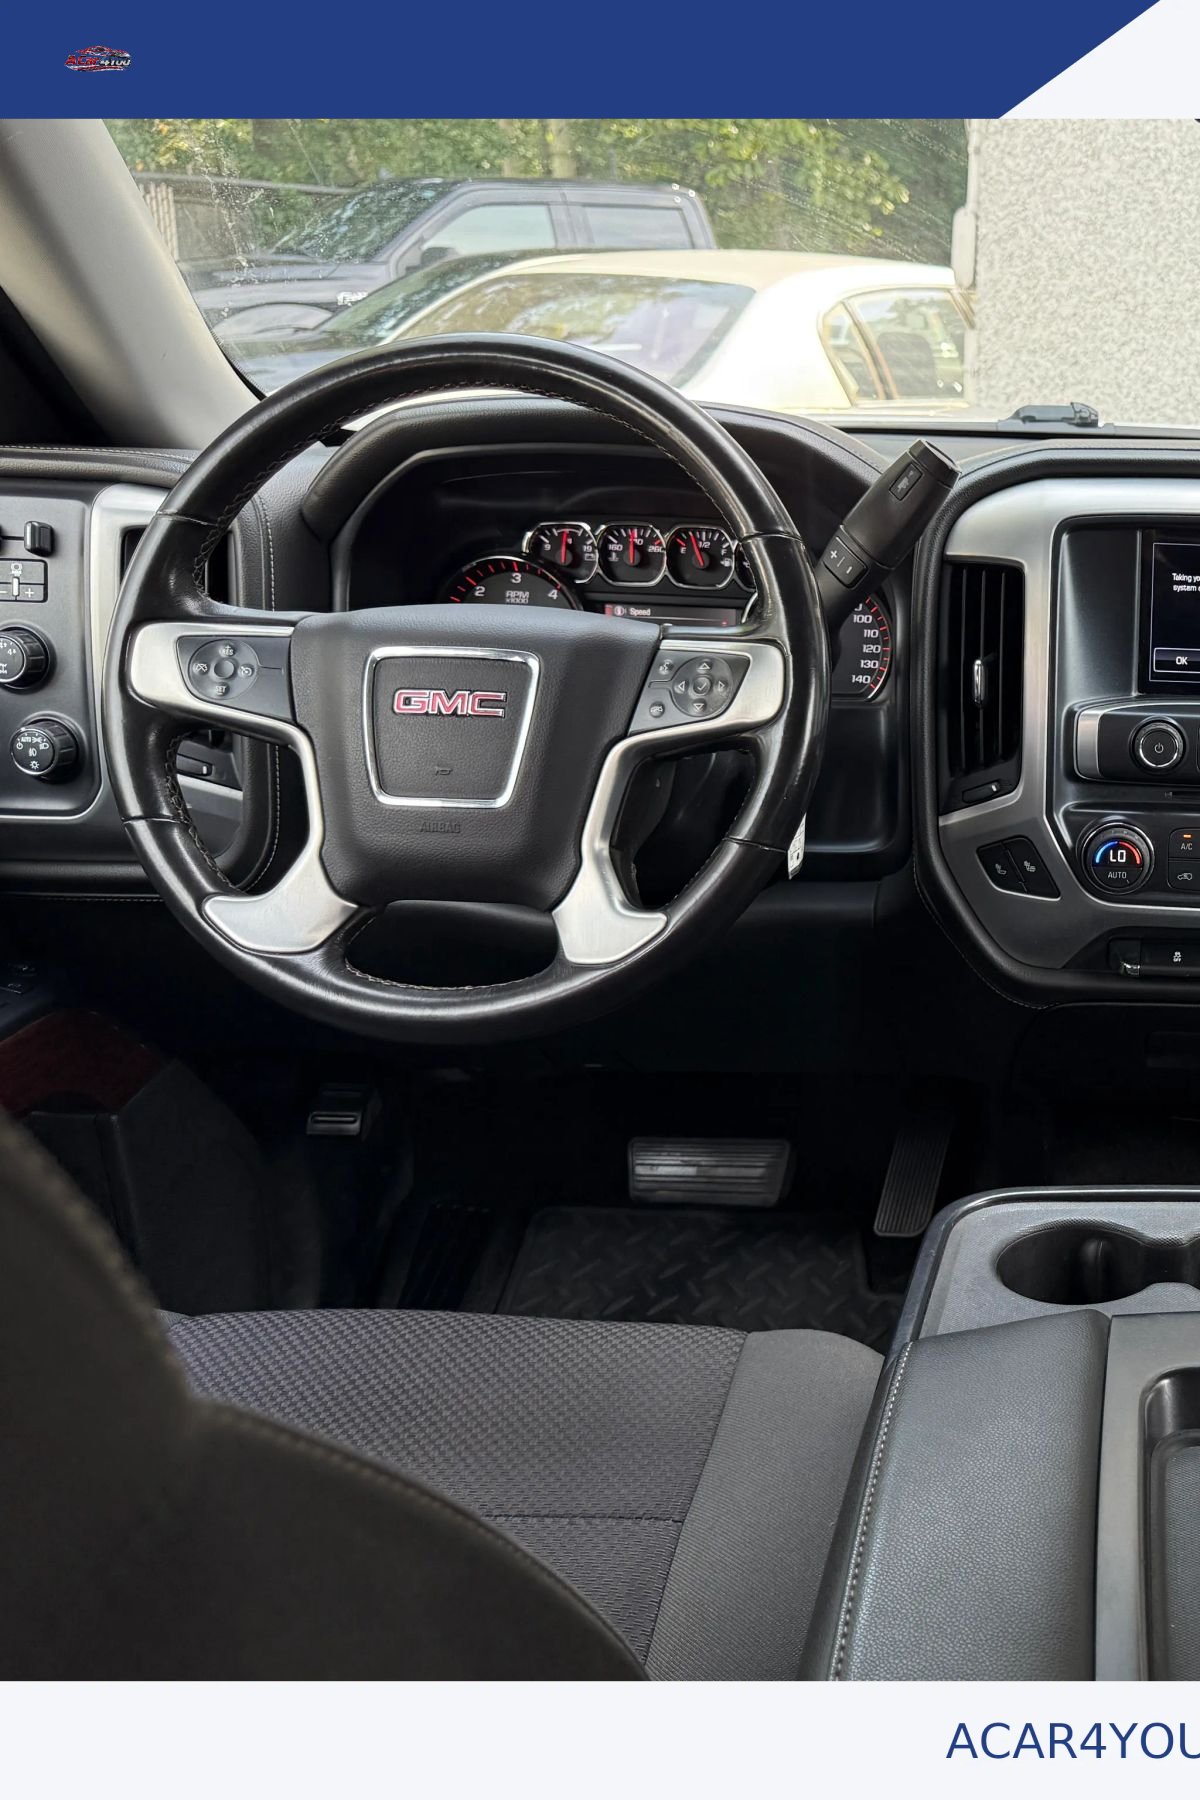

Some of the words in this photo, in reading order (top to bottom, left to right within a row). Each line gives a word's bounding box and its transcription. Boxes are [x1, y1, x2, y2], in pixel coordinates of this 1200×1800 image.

[511, 573, 522, 584] 3
[1172, 573, 1192, 583] Taking
[474, 586, 486, 596] 2
[1172, 584, 1197, 592] system
[505, 590, 530, 599] RPM
[547, 589, 558, 600] 4
[629, 607, 651, 616] Speed
[853, 614, 873, 624] 100
[863, 629, 879, 638] 110
[862, 644, 881, 653] 120
[860, 660, 879, 669] 130
[1175, 656, 1189, 666] OK
[851, 675, 871, 684] 140
[215, 685, 227, 693] SET
[392, 689, 507, 718] GMC
[419, 821, 461, 833] AIRBAG
[1109, 849, 1127, 863] LO
[1107, 871, 1127, 879] AUTO
